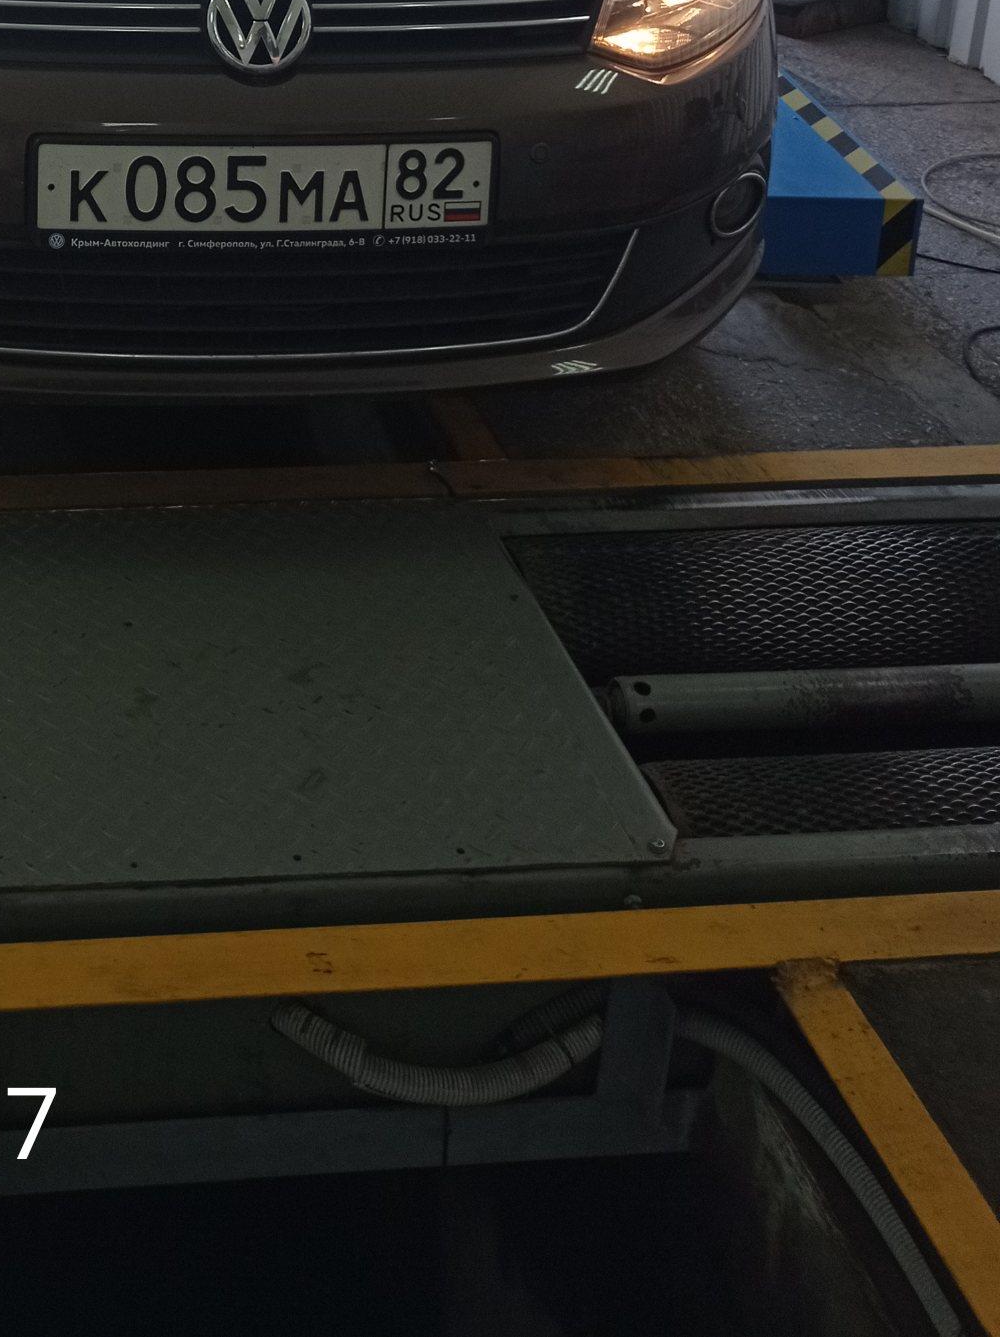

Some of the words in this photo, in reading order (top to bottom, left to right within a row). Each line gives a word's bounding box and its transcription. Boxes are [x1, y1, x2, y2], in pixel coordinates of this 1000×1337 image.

[395, 148, 466, 201] 82
[390, 203, 442, 222] RUS
[71, 238, 170, 249] Крым-Автохолдинг
